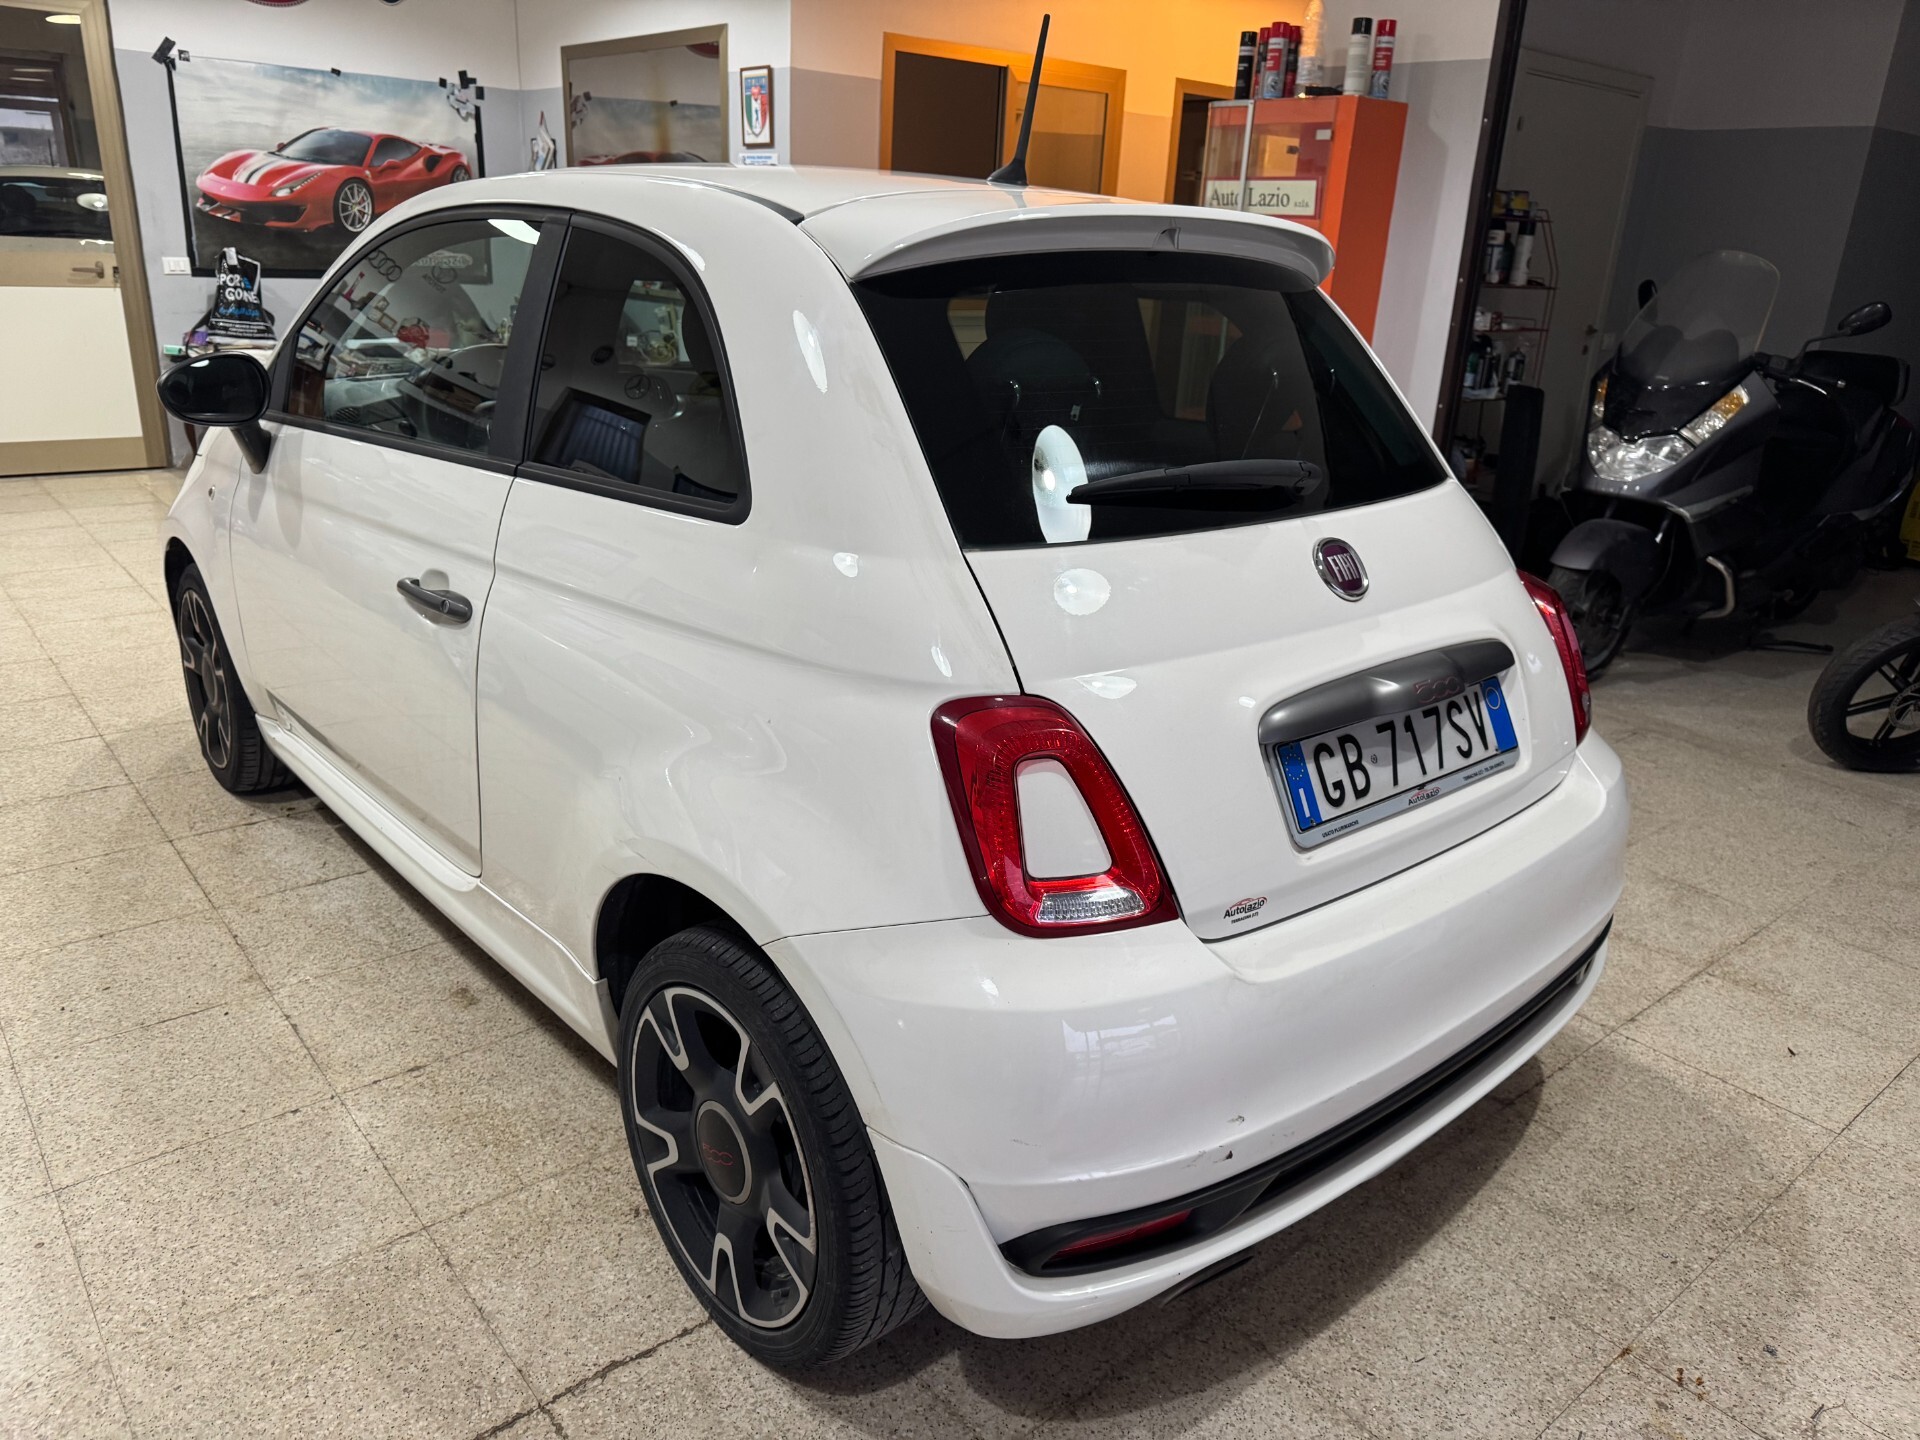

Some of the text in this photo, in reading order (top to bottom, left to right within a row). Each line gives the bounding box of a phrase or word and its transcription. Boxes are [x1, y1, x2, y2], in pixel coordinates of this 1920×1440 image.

[1248, 187, 1291, 208] Lazio
[225, 287, 260, 304] GONE
[1326, 552, 1360, 583] FIAT
[1413, 676, 1461, 704] 500
[1313, 691, 1489, 808] GB 717SV
[702, 1142, 734, 1166] 500
